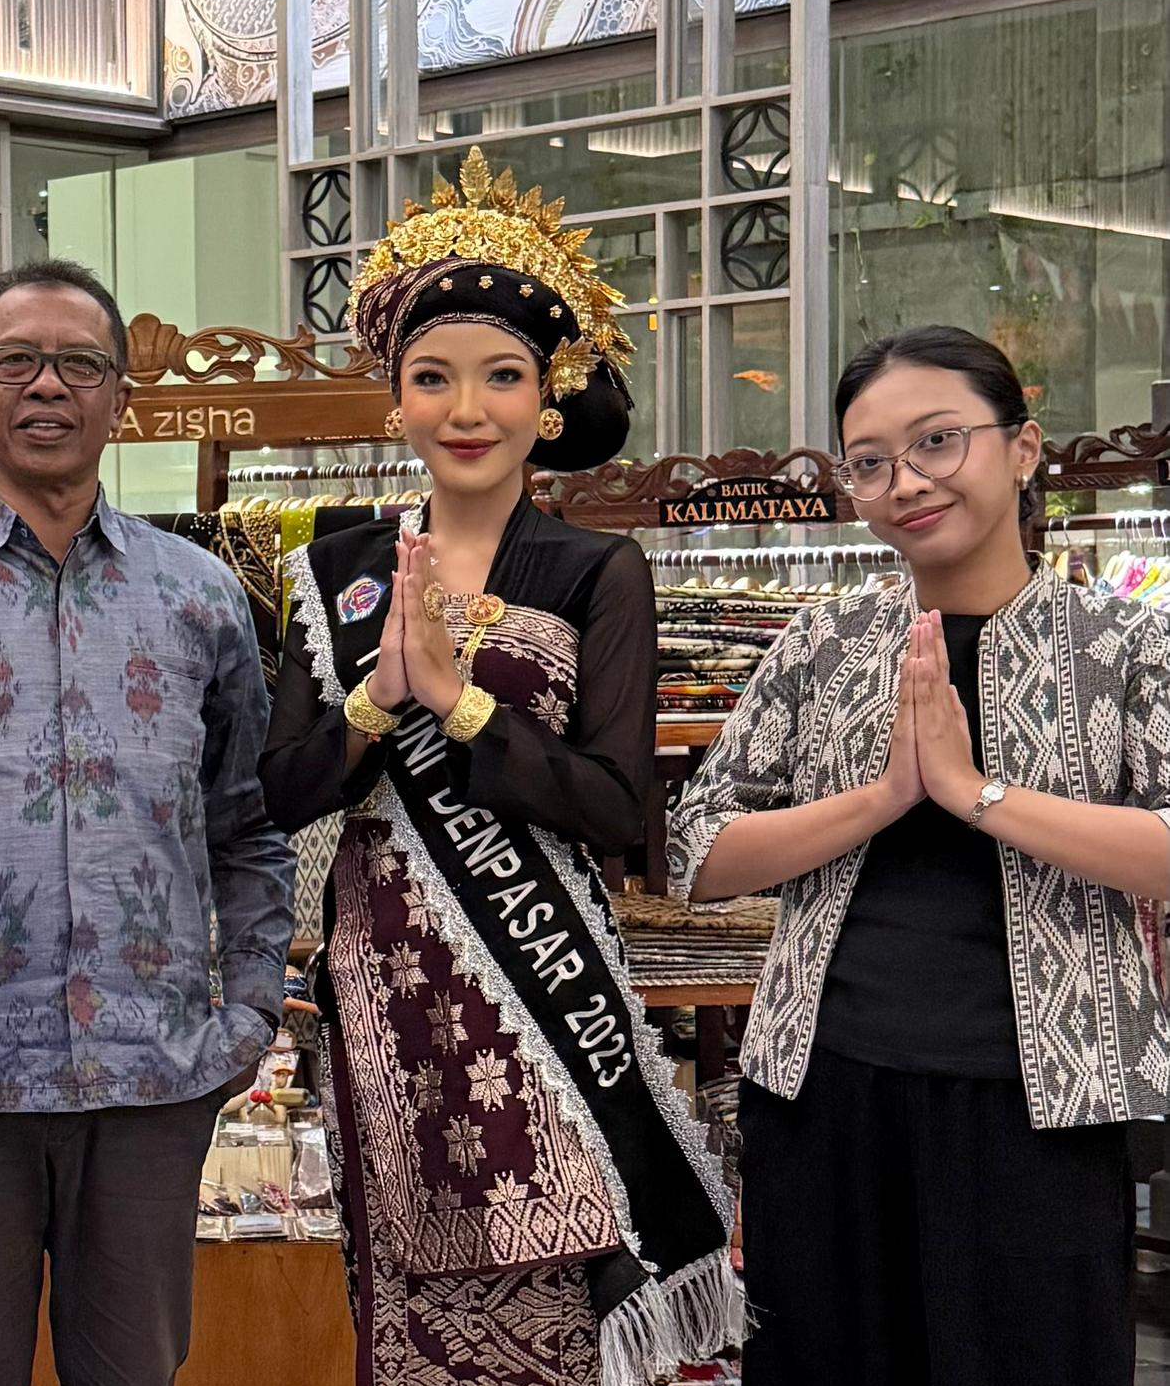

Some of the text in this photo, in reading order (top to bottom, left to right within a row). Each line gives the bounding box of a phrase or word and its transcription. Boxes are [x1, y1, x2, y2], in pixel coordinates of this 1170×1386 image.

[720, 482, 769, 498] BATIK
[665, 497, 830, 523] KALIMATAYA
[564, 993, 631, 1088] 2023
